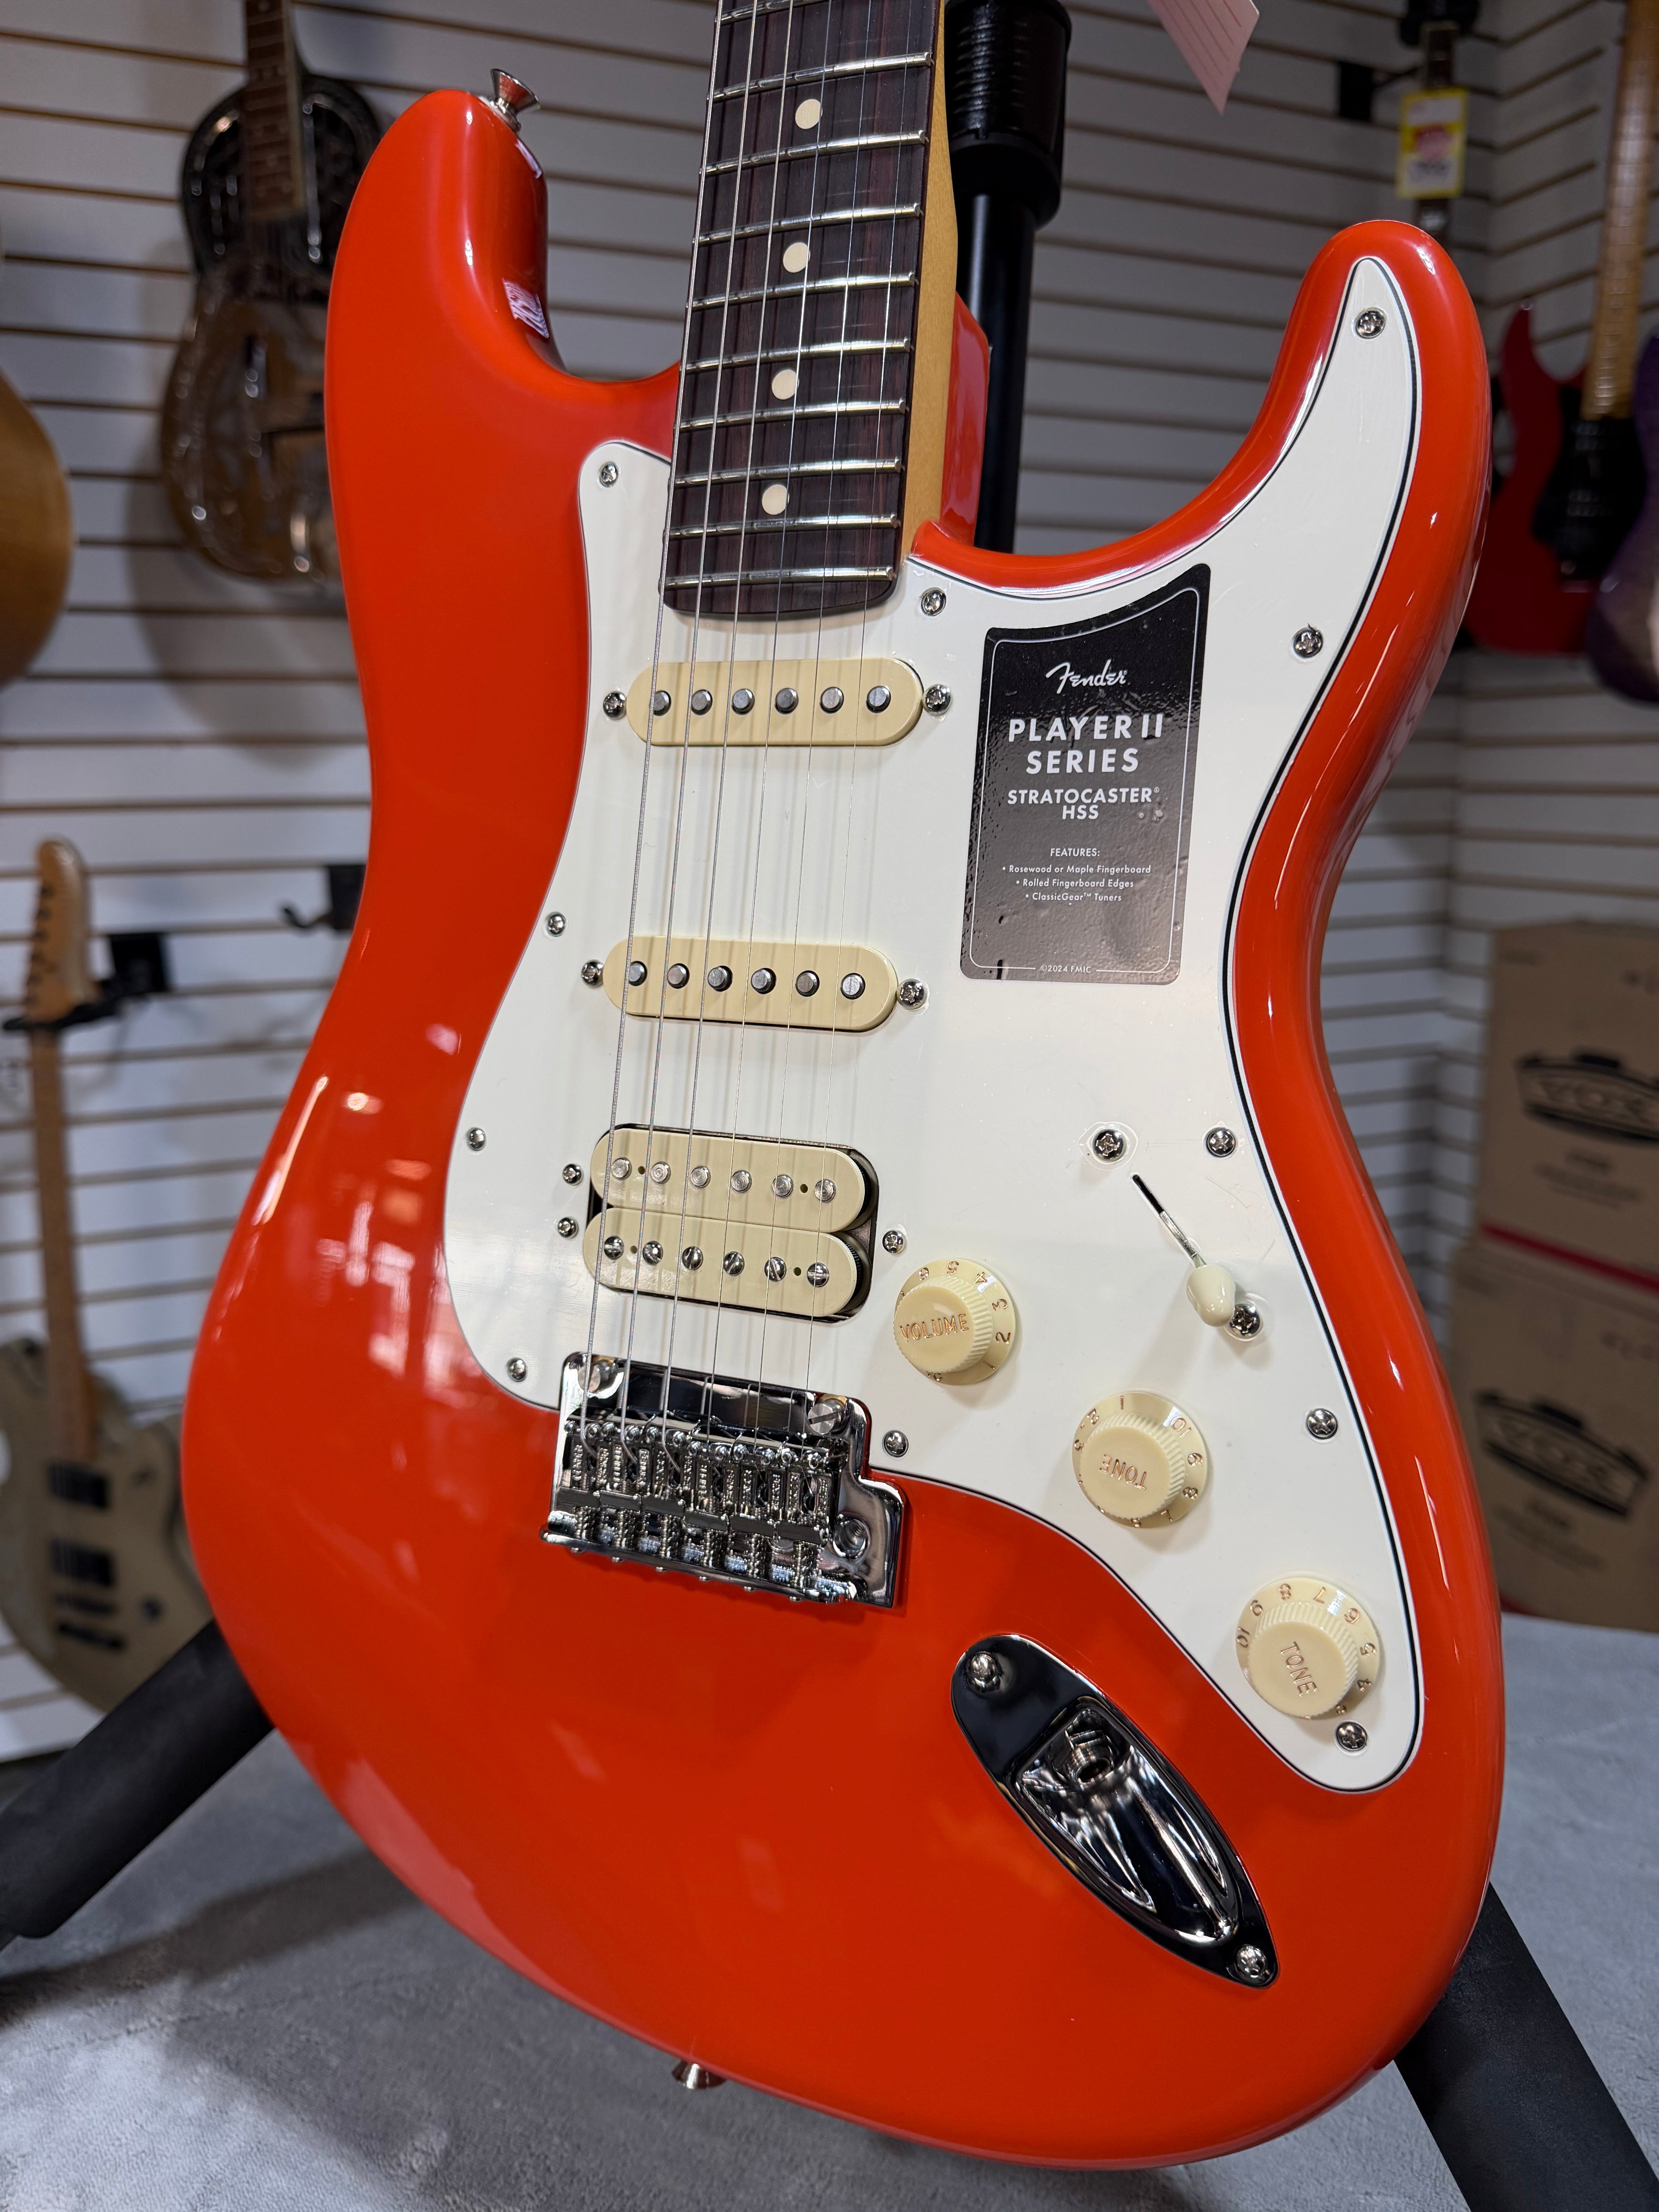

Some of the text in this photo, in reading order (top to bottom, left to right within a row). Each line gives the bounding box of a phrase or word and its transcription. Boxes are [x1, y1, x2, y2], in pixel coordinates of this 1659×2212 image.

[1008, 714, 1163, 742] PLAYER II
[1026, 748, 1139, 775] SERIES
[1062, 804, 1099, 820] HSS
[1050, 848, 1101, 857] FEATURES:
[1009, 864, 1052, 873] Rosewood
[1066, 864, 1094, 875] Maple
[1097, 864, 1151, 875] Fingerboard
[1022, 878, 1134, 890] Rolled Fingerboard Edges
[1094, 893, 1122, 902] Tuners
[946, 1261, 960, 1275] 5
[973, 1271, 988, 1285] 4
[991, 1298, 1008, 1311] 3
[900, 1313, 969, 1342] VOLUME
[995, 1331, 1012, 1345] 2
[1170, 1417, 1192, 1439] 10
[1099, 1454, 1147, 1491] TONE
[1313, 1586, 1326, 1604] 7
[1280, 1641, 1318, 1698] TONE
